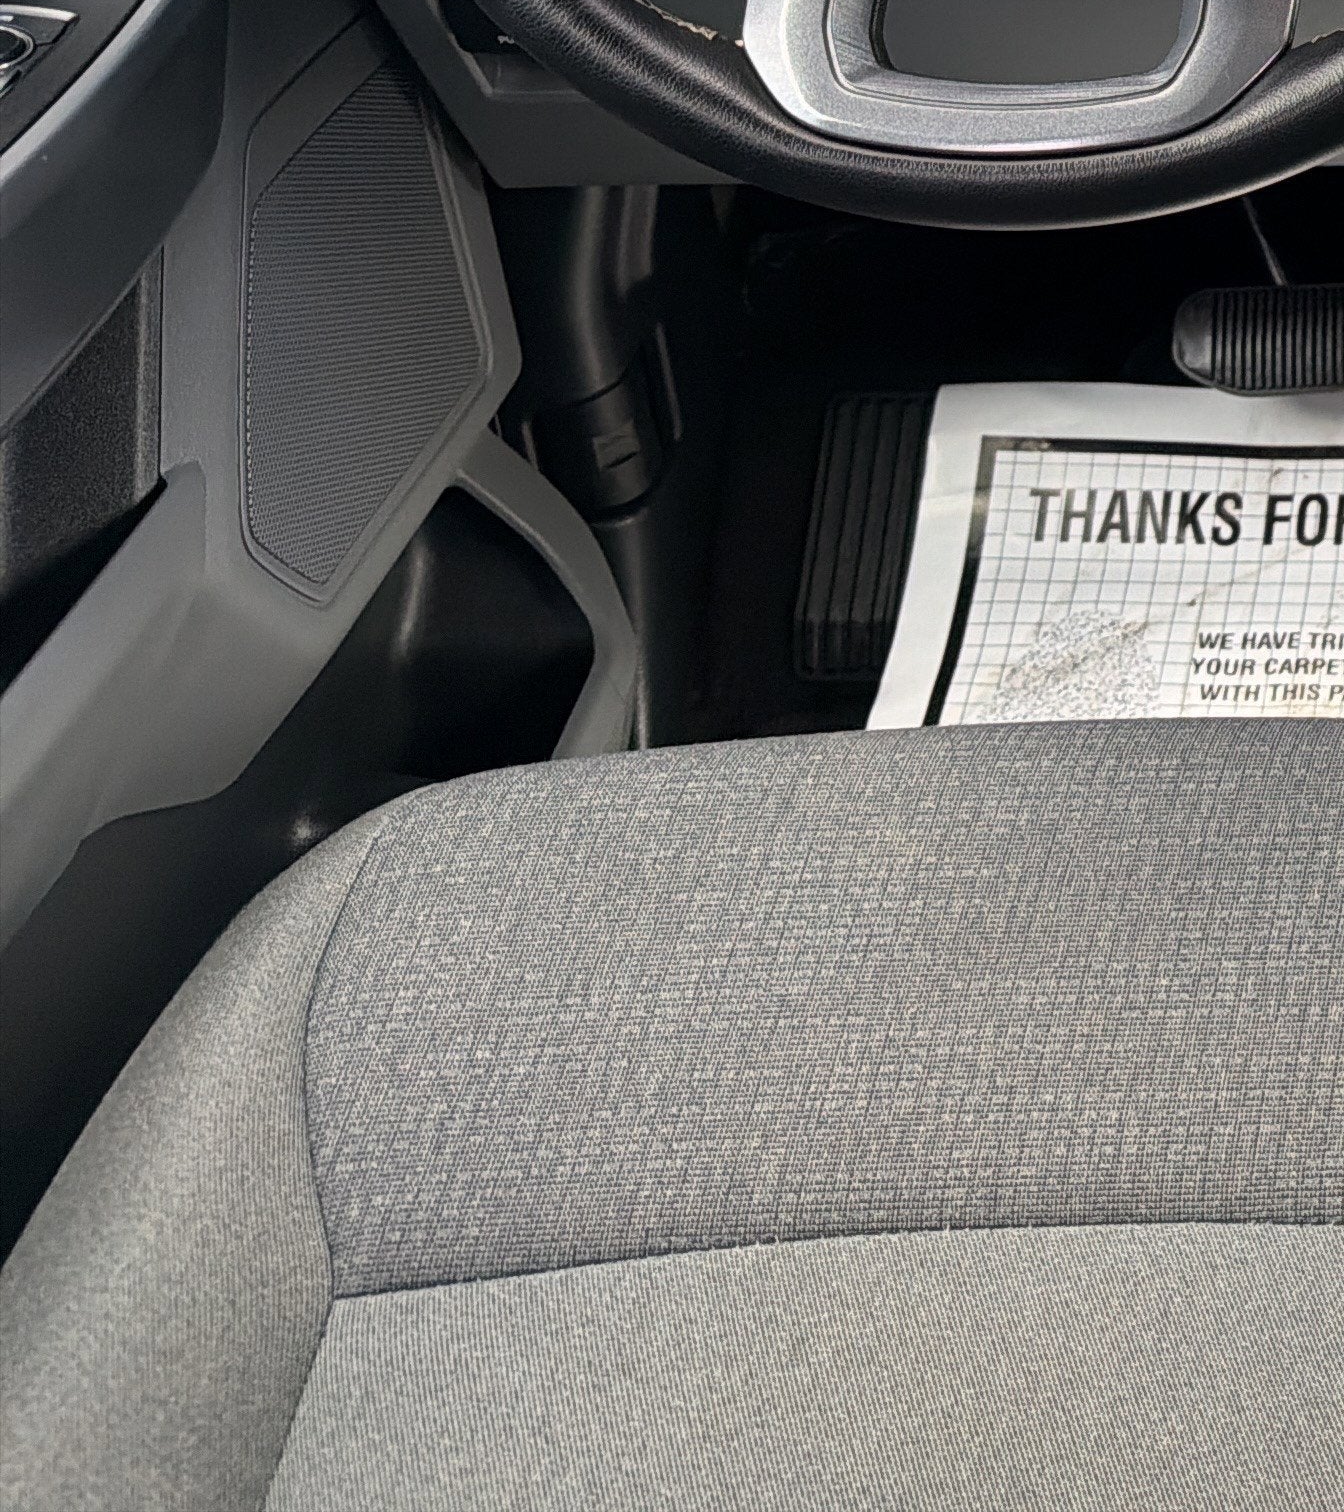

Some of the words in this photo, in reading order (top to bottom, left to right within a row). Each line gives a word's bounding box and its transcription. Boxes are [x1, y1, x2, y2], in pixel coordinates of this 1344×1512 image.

[1030, 488, 1243, 546] THANKS
[1198, 632, 1234, 650] WE
[1241, 632, 1301, 650] HAVE
[1191, 658, 1255, 676] YOUR
[1200, 683, 1259, 701] WITH
[1270, 683, 1321, 701] THIS
